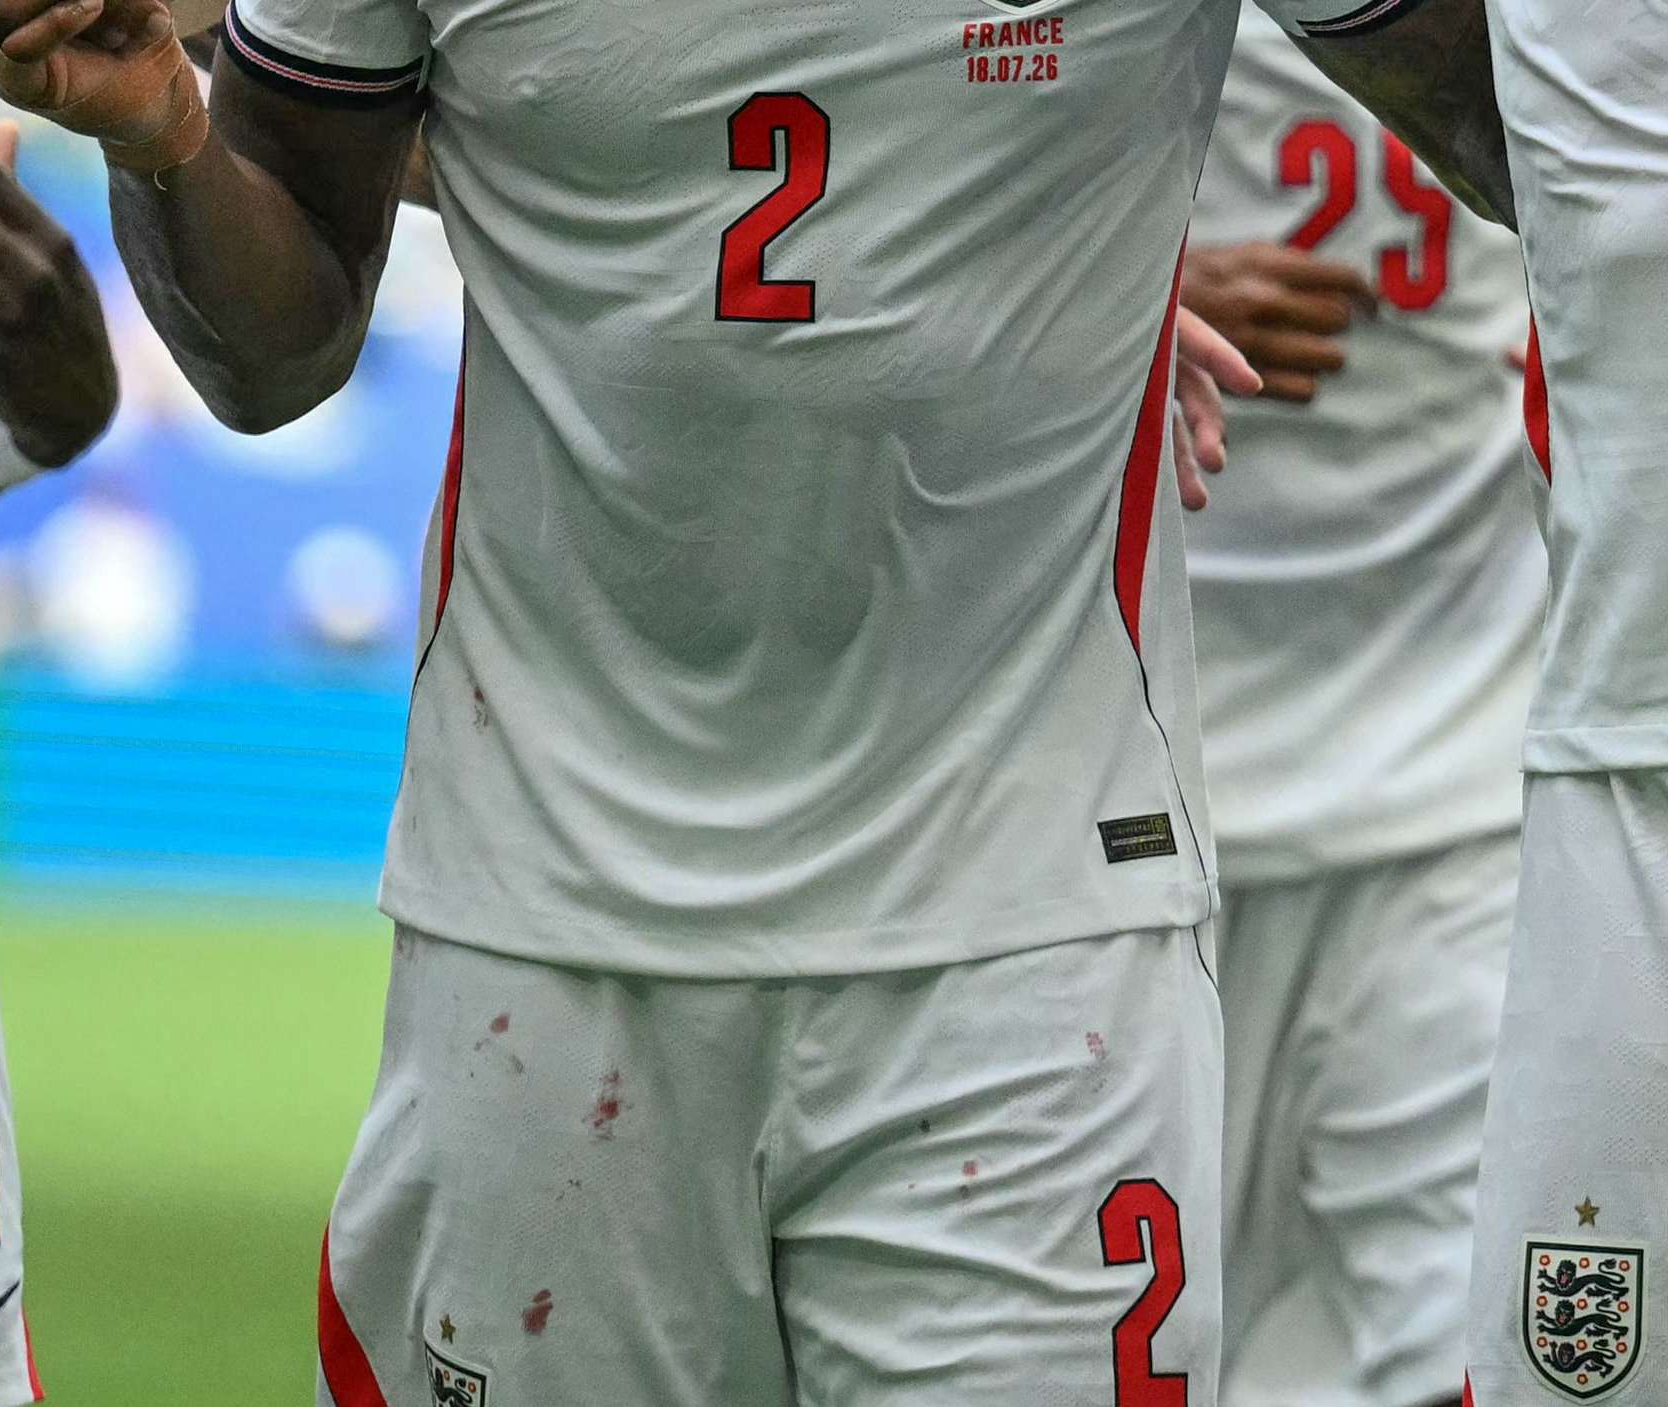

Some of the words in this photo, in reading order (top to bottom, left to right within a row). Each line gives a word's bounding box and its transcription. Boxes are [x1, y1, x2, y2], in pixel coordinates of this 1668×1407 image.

[962, 17, 1064, 49] FRANCE
[967, 54, 1059, 83] 18.07.26
[714, 91, 831, 322] 2
[1278, 120, 1454, 312] 25
[1097, 1178, 1188, 1407] 2
